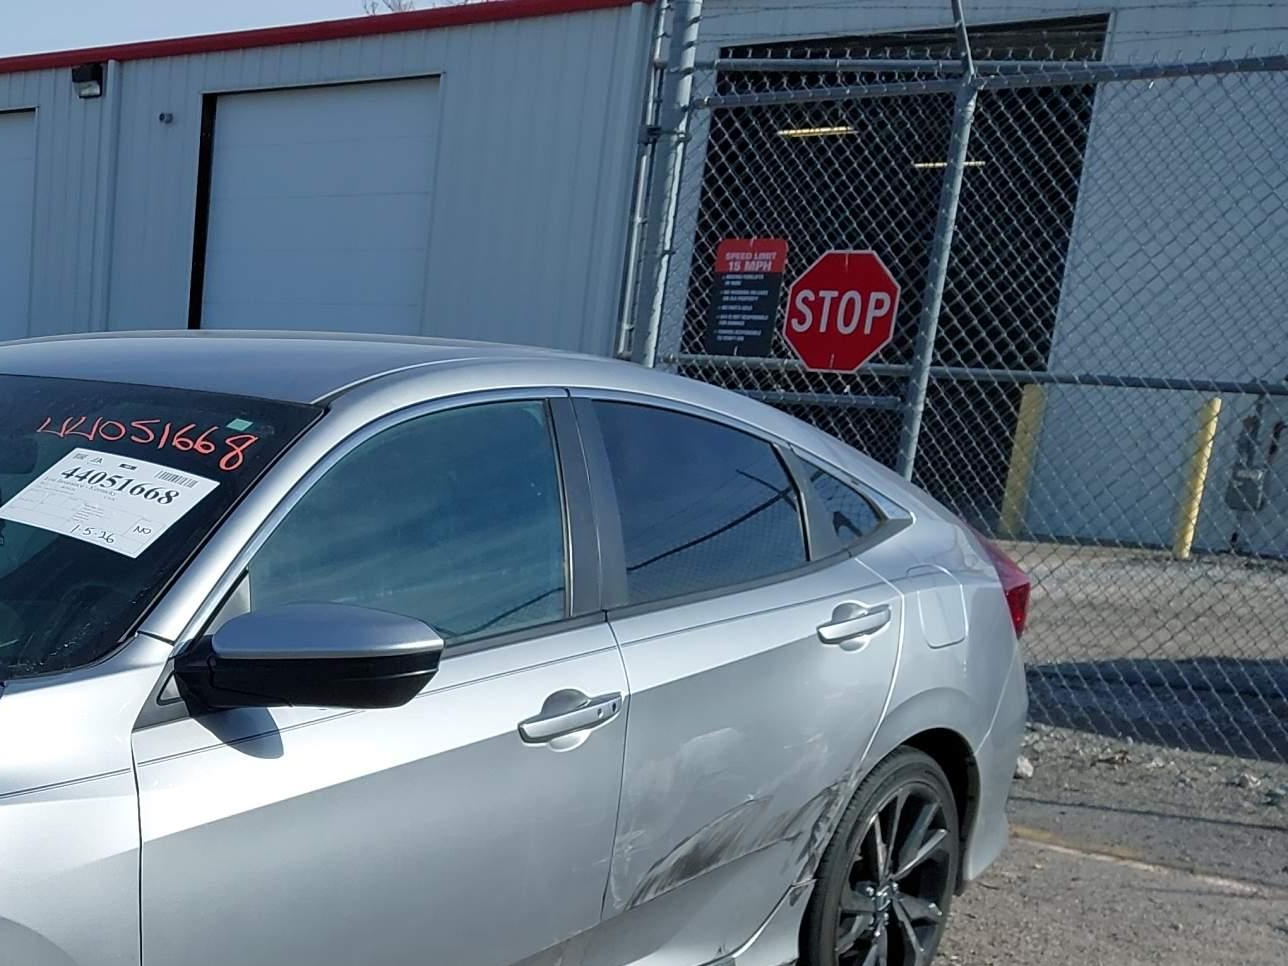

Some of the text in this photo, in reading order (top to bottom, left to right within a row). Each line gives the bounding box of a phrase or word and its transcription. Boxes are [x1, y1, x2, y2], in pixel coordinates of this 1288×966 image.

[726, 252, 753, 260] SPEED
[728, 261, 772, 271] 15 MPH
[791, 289, 891, 334] STOP
[37, 417, 258, 470] 44051668
[60, 465, 180, 505] 44051668
